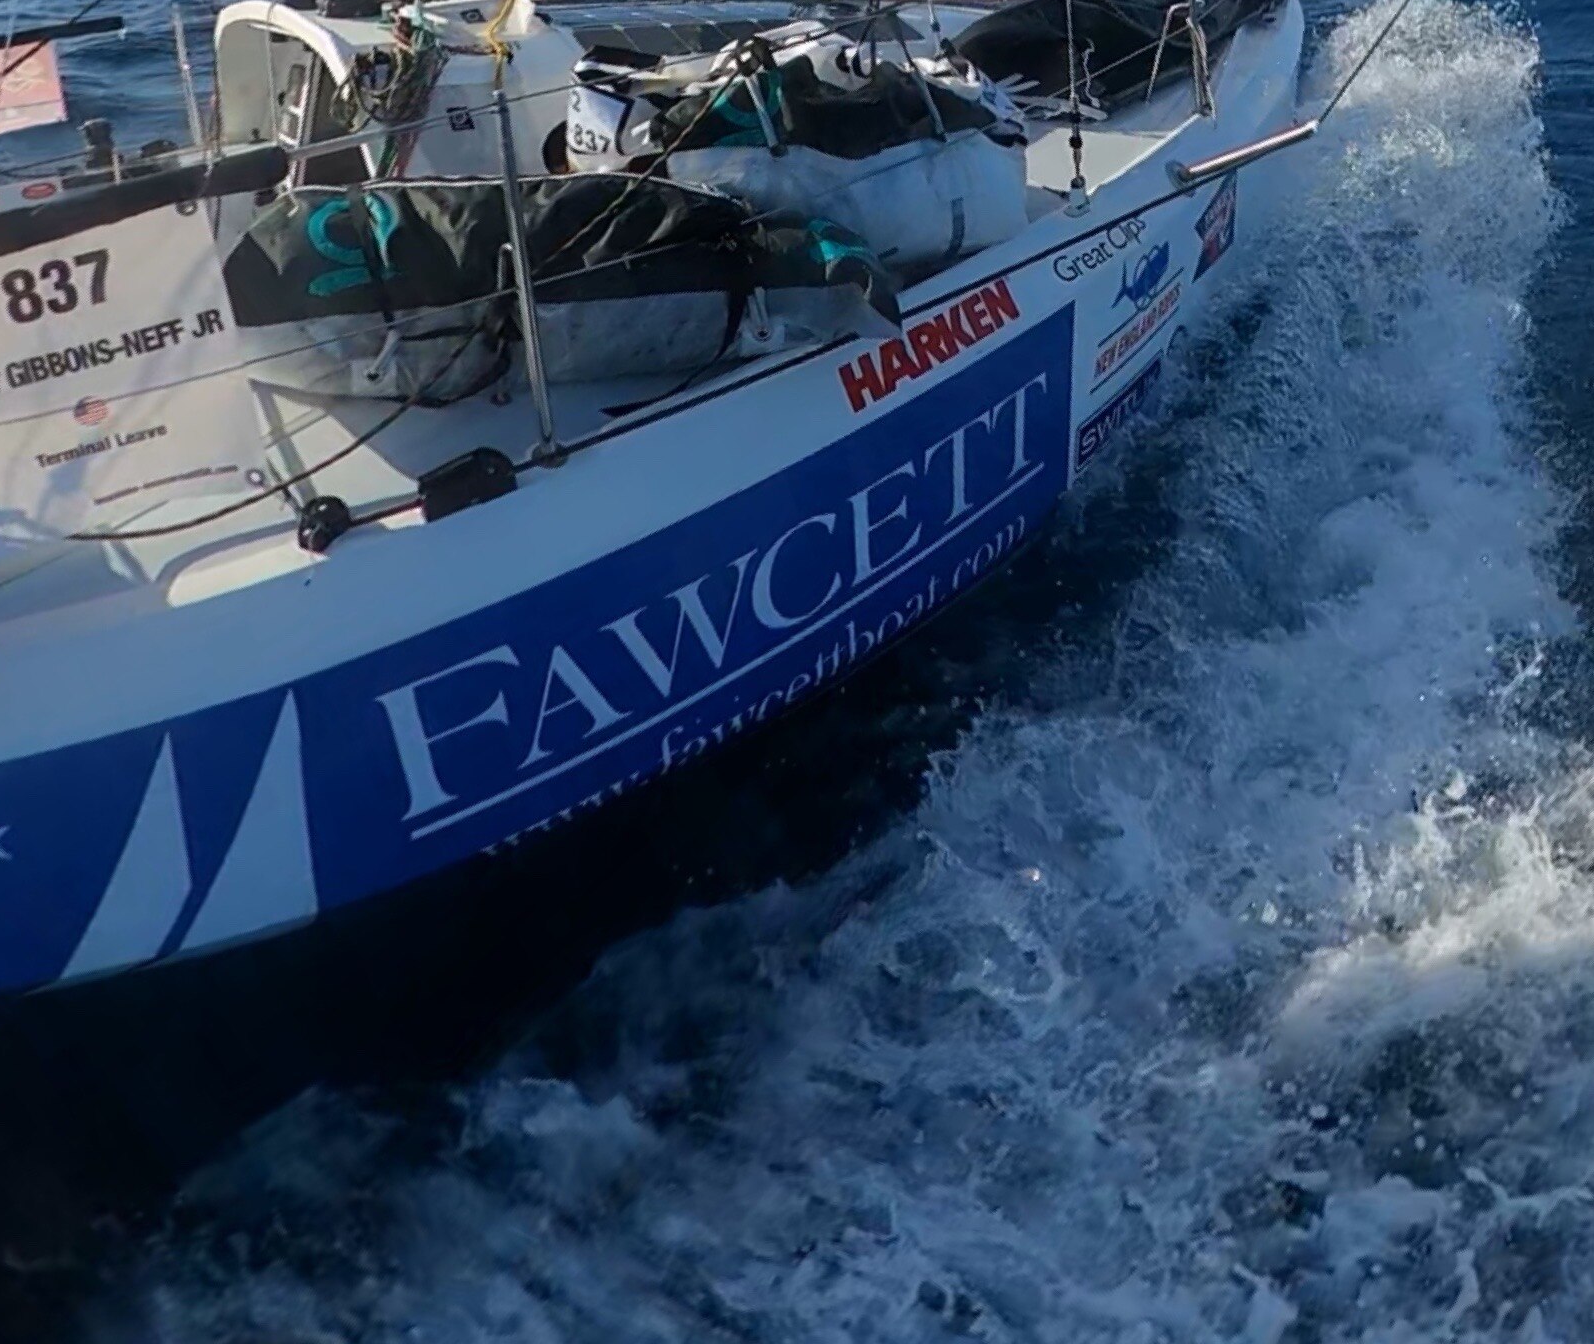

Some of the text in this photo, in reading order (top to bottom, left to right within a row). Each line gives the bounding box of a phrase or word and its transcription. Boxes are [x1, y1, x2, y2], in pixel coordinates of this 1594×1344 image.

[574, 123, 611, 154] 837
[0, 248, 112, 325] 837
[1053, 215, 1147, 283] Great Clips
[6, 323, 184, 391] GIBBONS-NEFF
[190, 307, 224, 340] JR
[837, 278, 1022, 414] HARKEN
[35, 424, 168, 468] Terminal Leave
[374, 372, 1050, 823] FAWCETT
